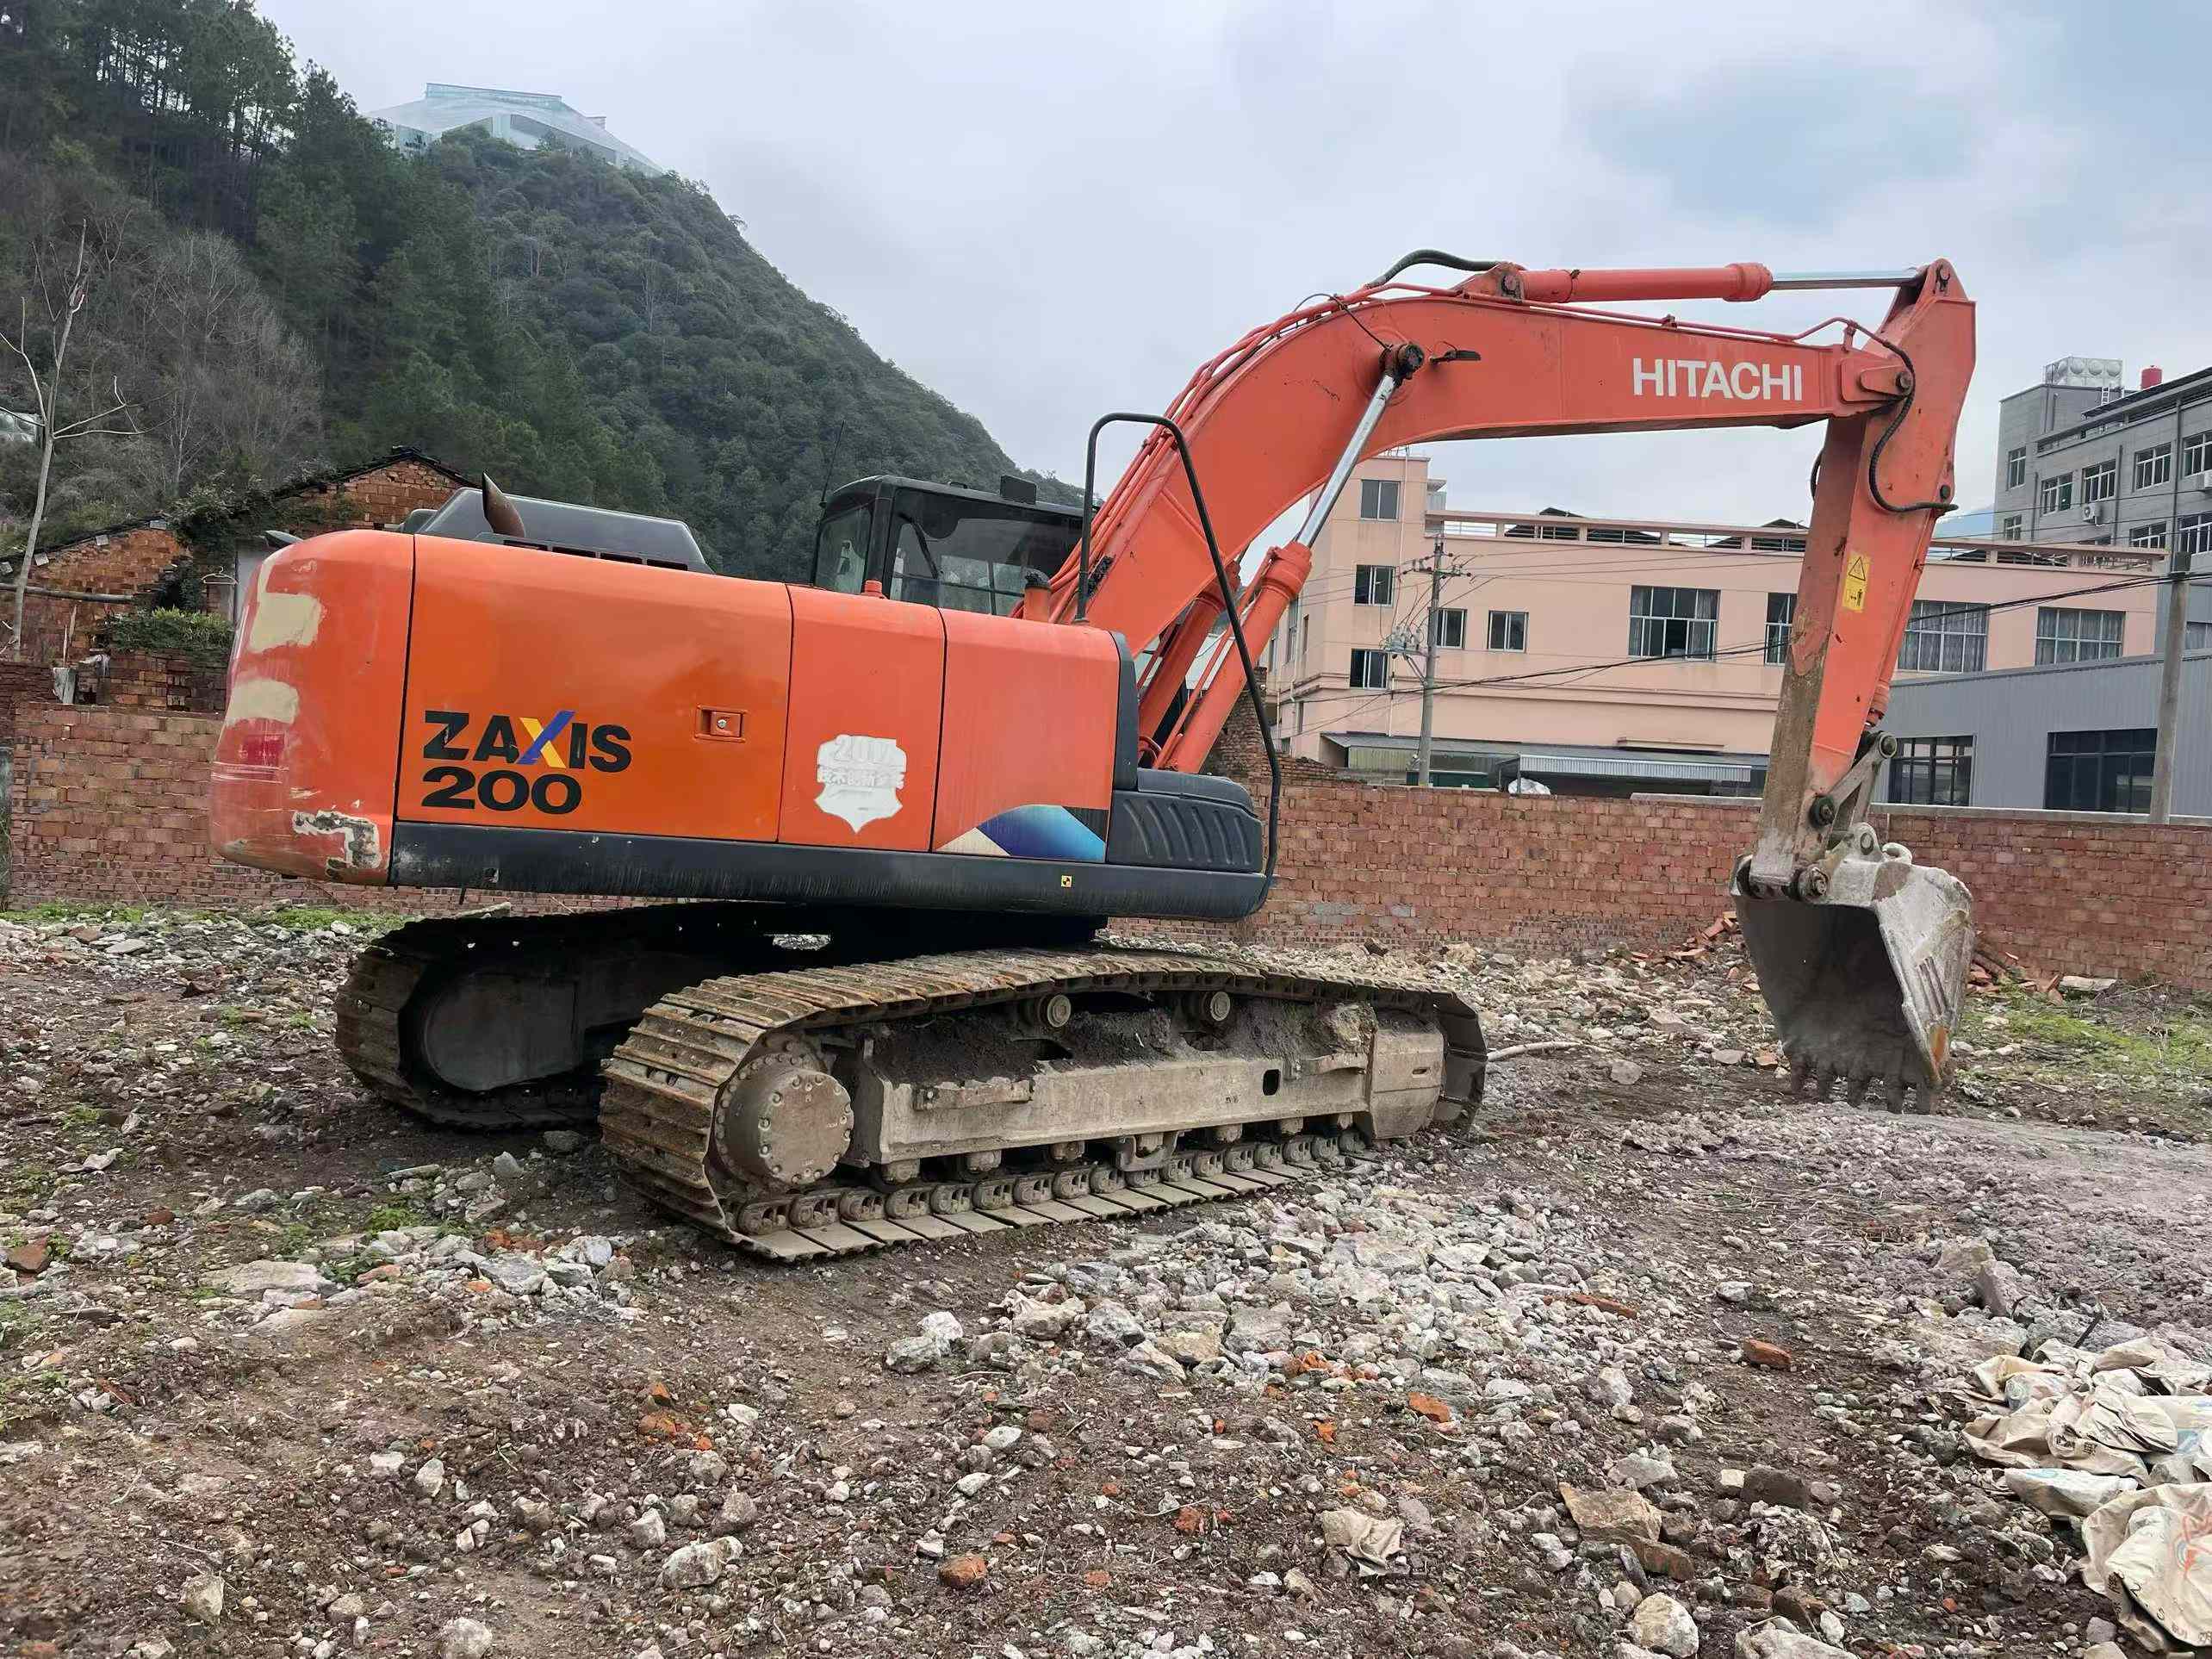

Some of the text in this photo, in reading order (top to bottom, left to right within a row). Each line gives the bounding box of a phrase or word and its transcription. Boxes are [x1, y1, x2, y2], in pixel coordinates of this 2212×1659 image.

[1633, 357, 1802, 401] HITACHI
[423, 710, 631, 773] ZAXIS
[421, 766, 581, 814] 200
